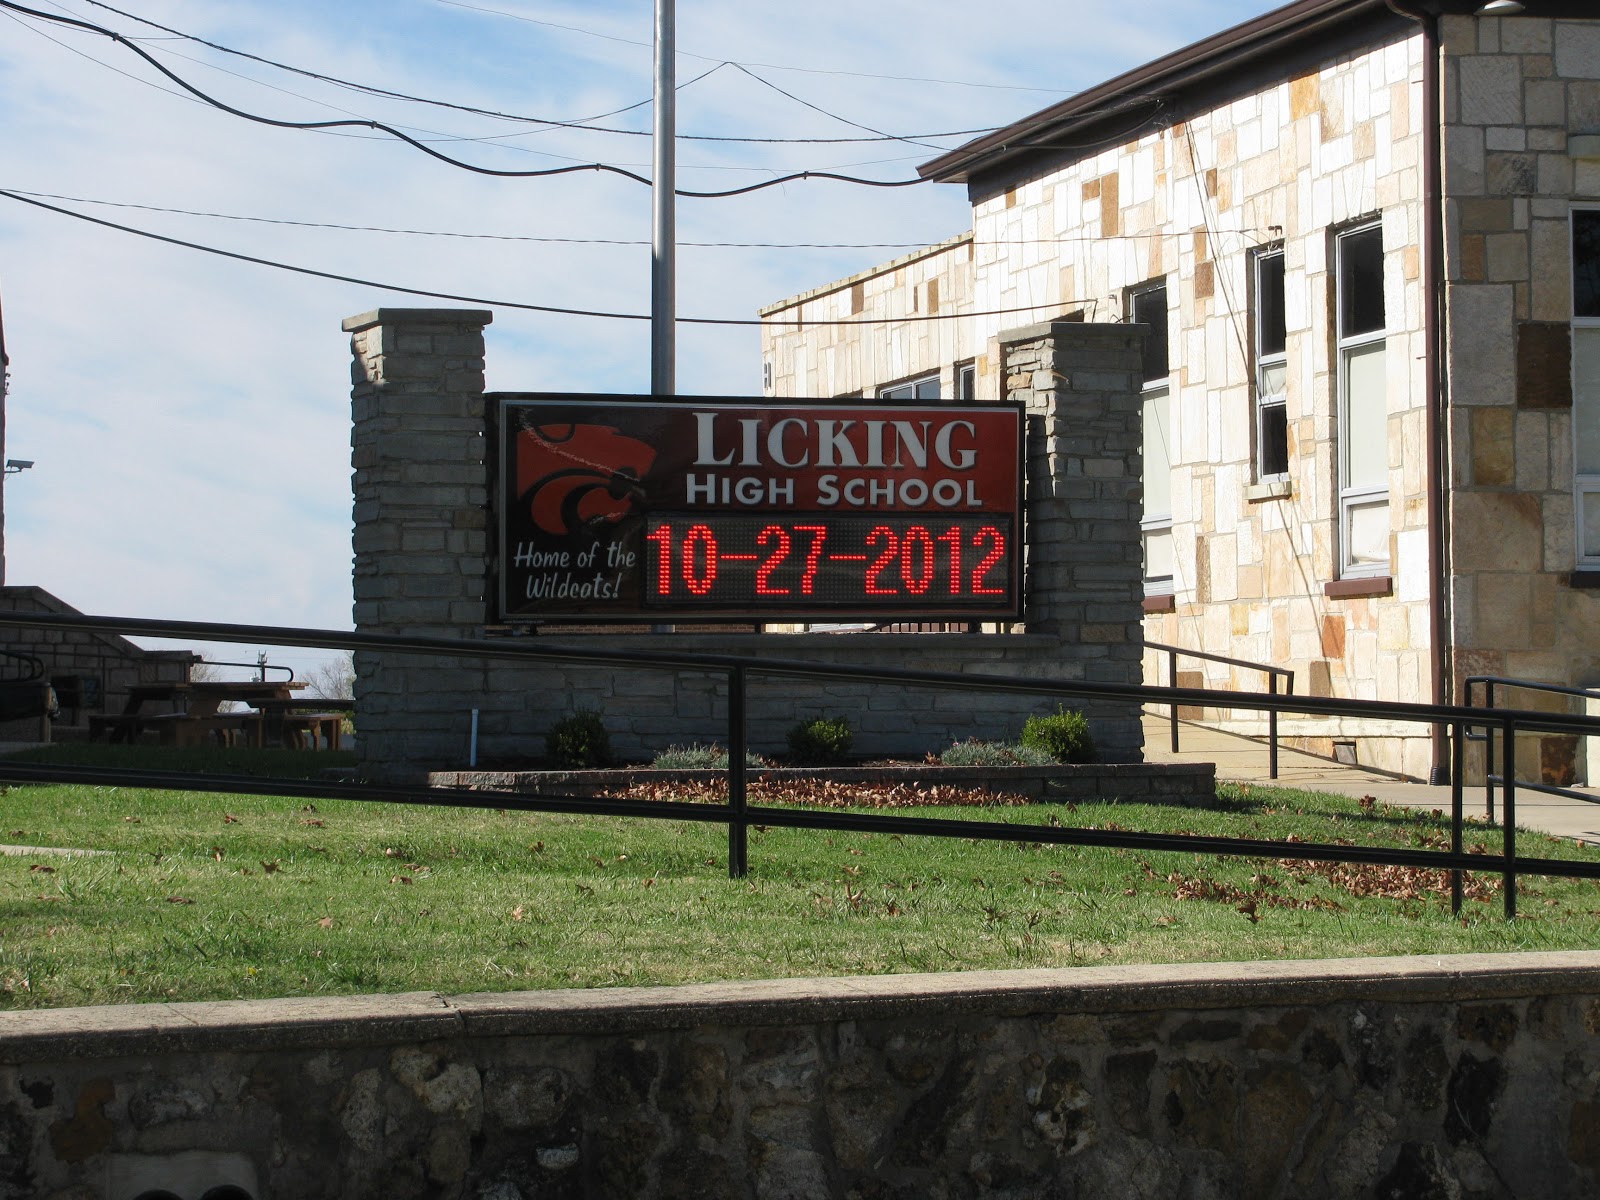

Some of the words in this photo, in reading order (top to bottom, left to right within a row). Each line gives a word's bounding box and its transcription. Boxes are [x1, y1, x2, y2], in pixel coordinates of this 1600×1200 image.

[692, 412, 978, 469] LICKING
[686, 473, 794, 505] HIGH
[816, 474, 983, 506] SCHOOL
[513, 541, 570, 568] Home
[577, 541, 600, 568] of
[606, 541, 636, 568] the
[646, 524, 1005, 595] 10-27-2012
[526, 572, 623, 599] Wildcats!
